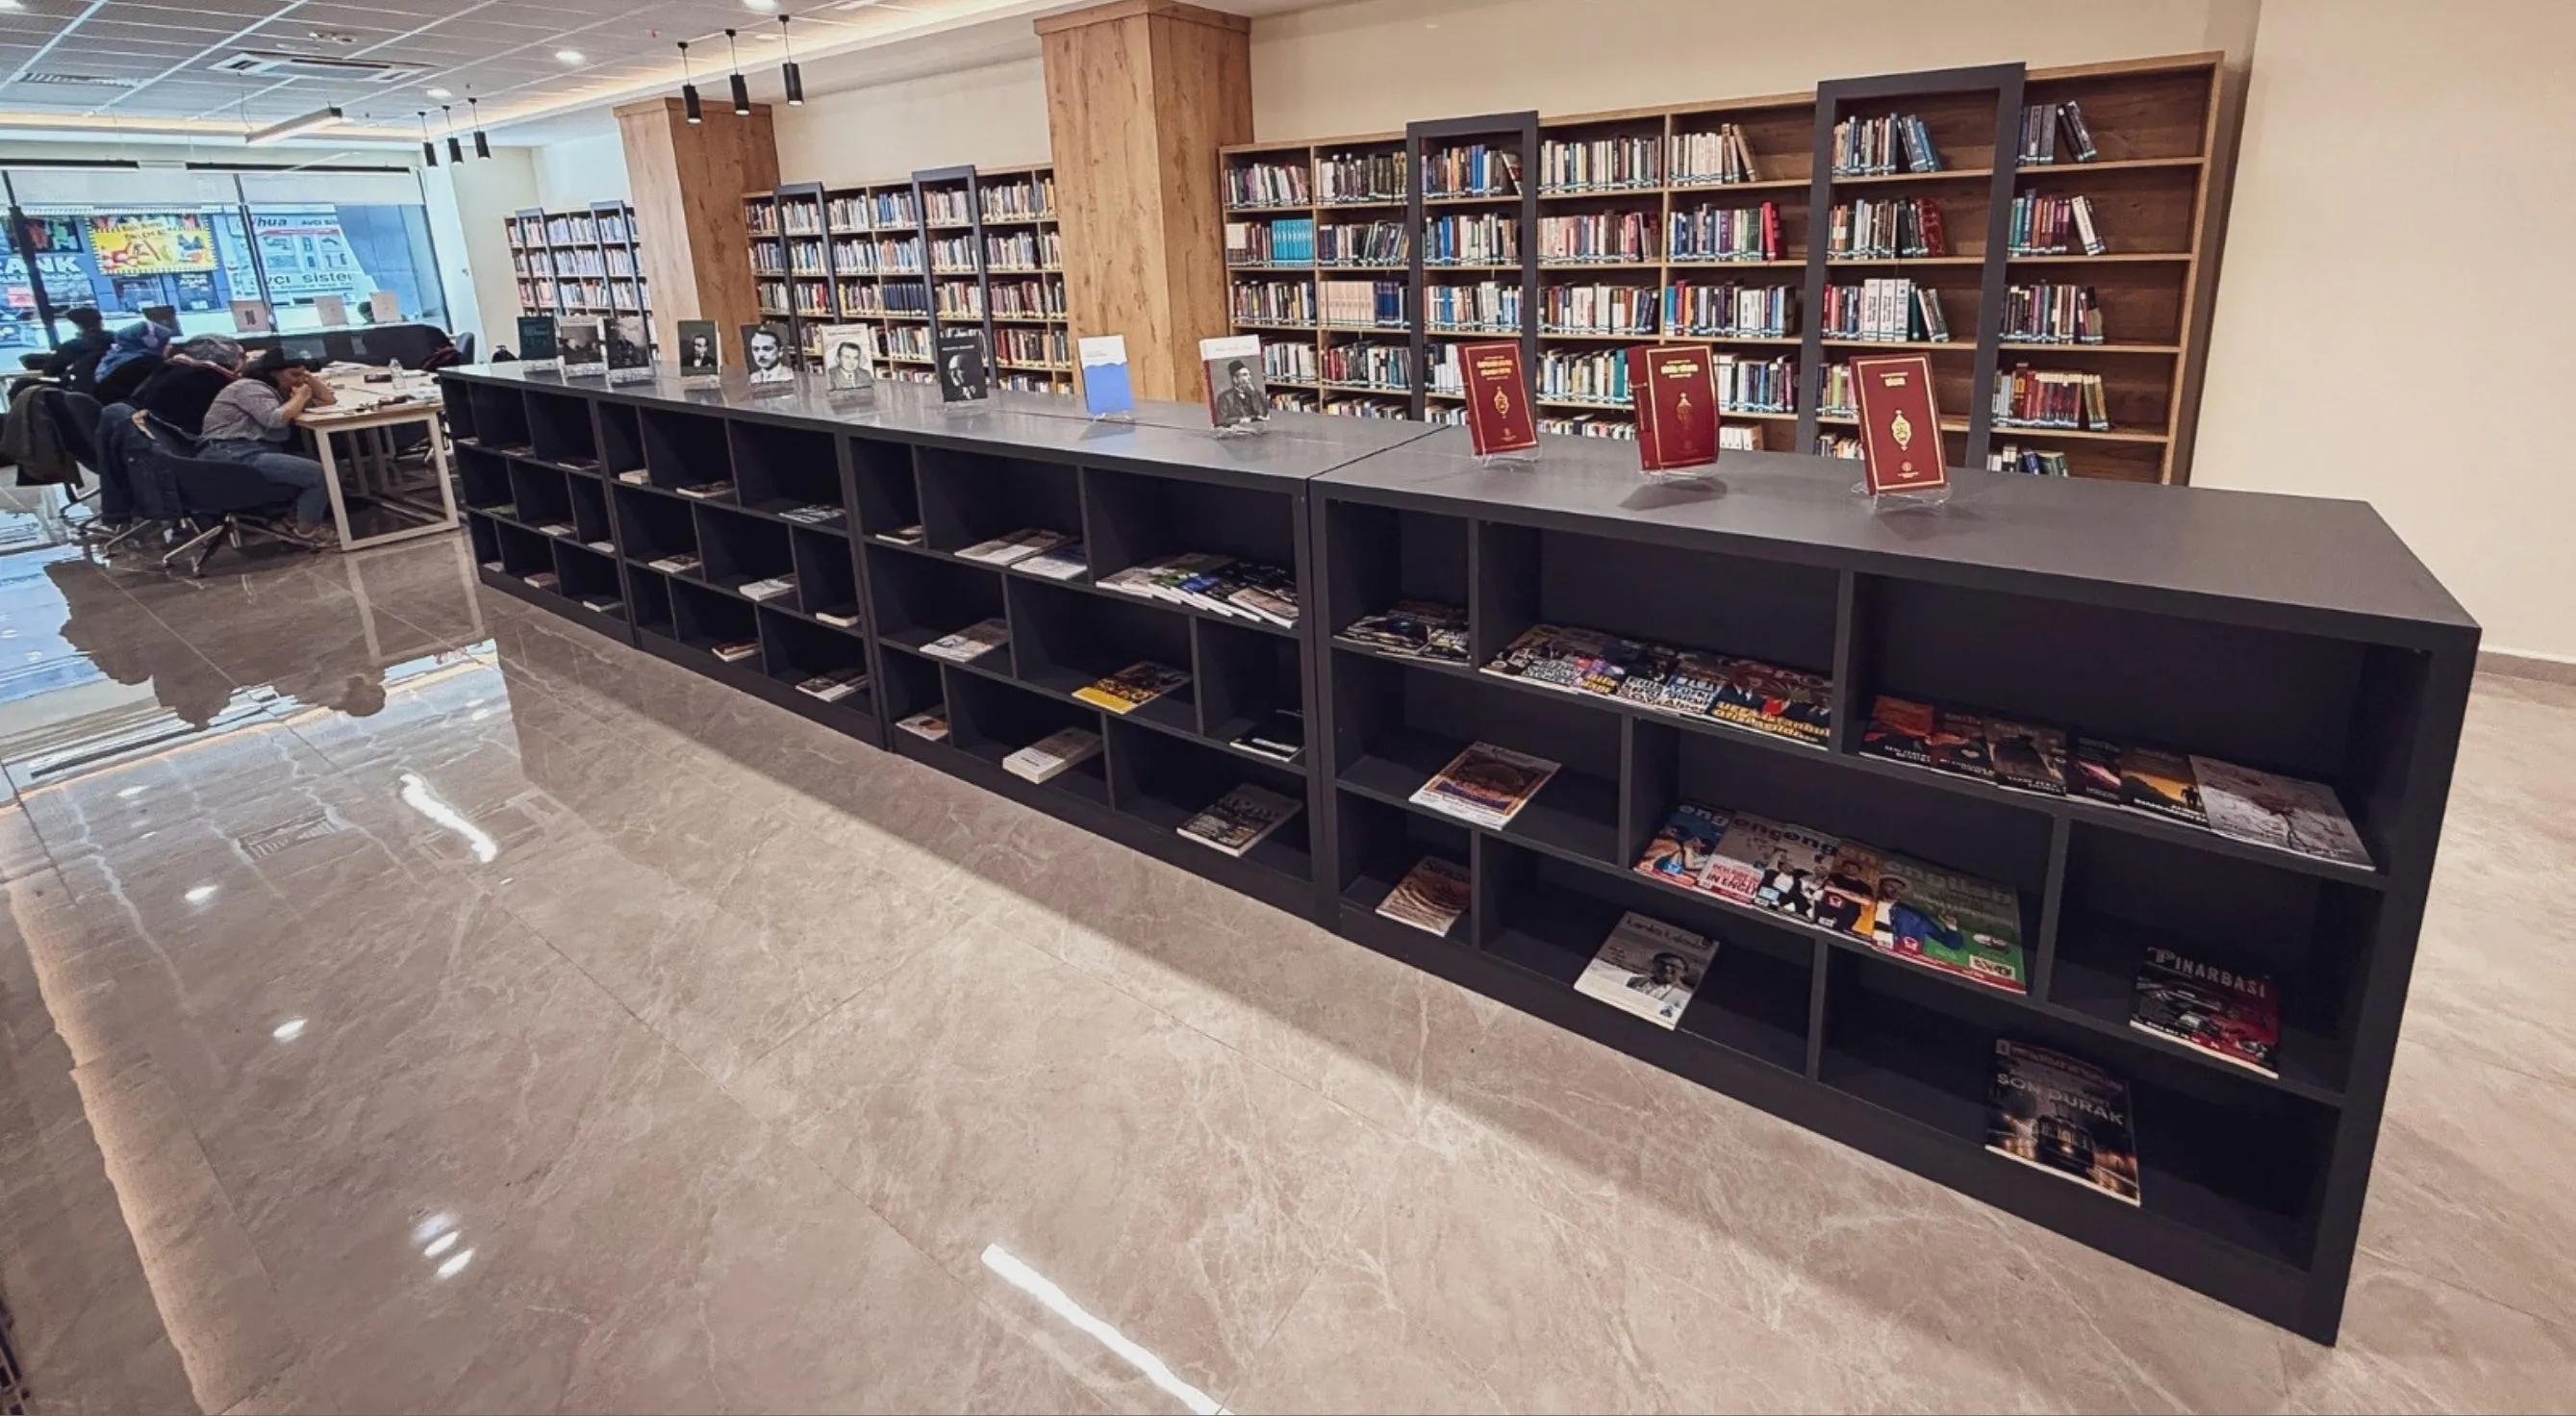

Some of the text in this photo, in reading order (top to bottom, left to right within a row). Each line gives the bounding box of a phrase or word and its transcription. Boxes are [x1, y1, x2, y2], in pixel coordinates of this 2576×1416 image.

[1679, 804, 1730, 827] eng
[1997, 1073, 2125, 1126] SON DURAK
